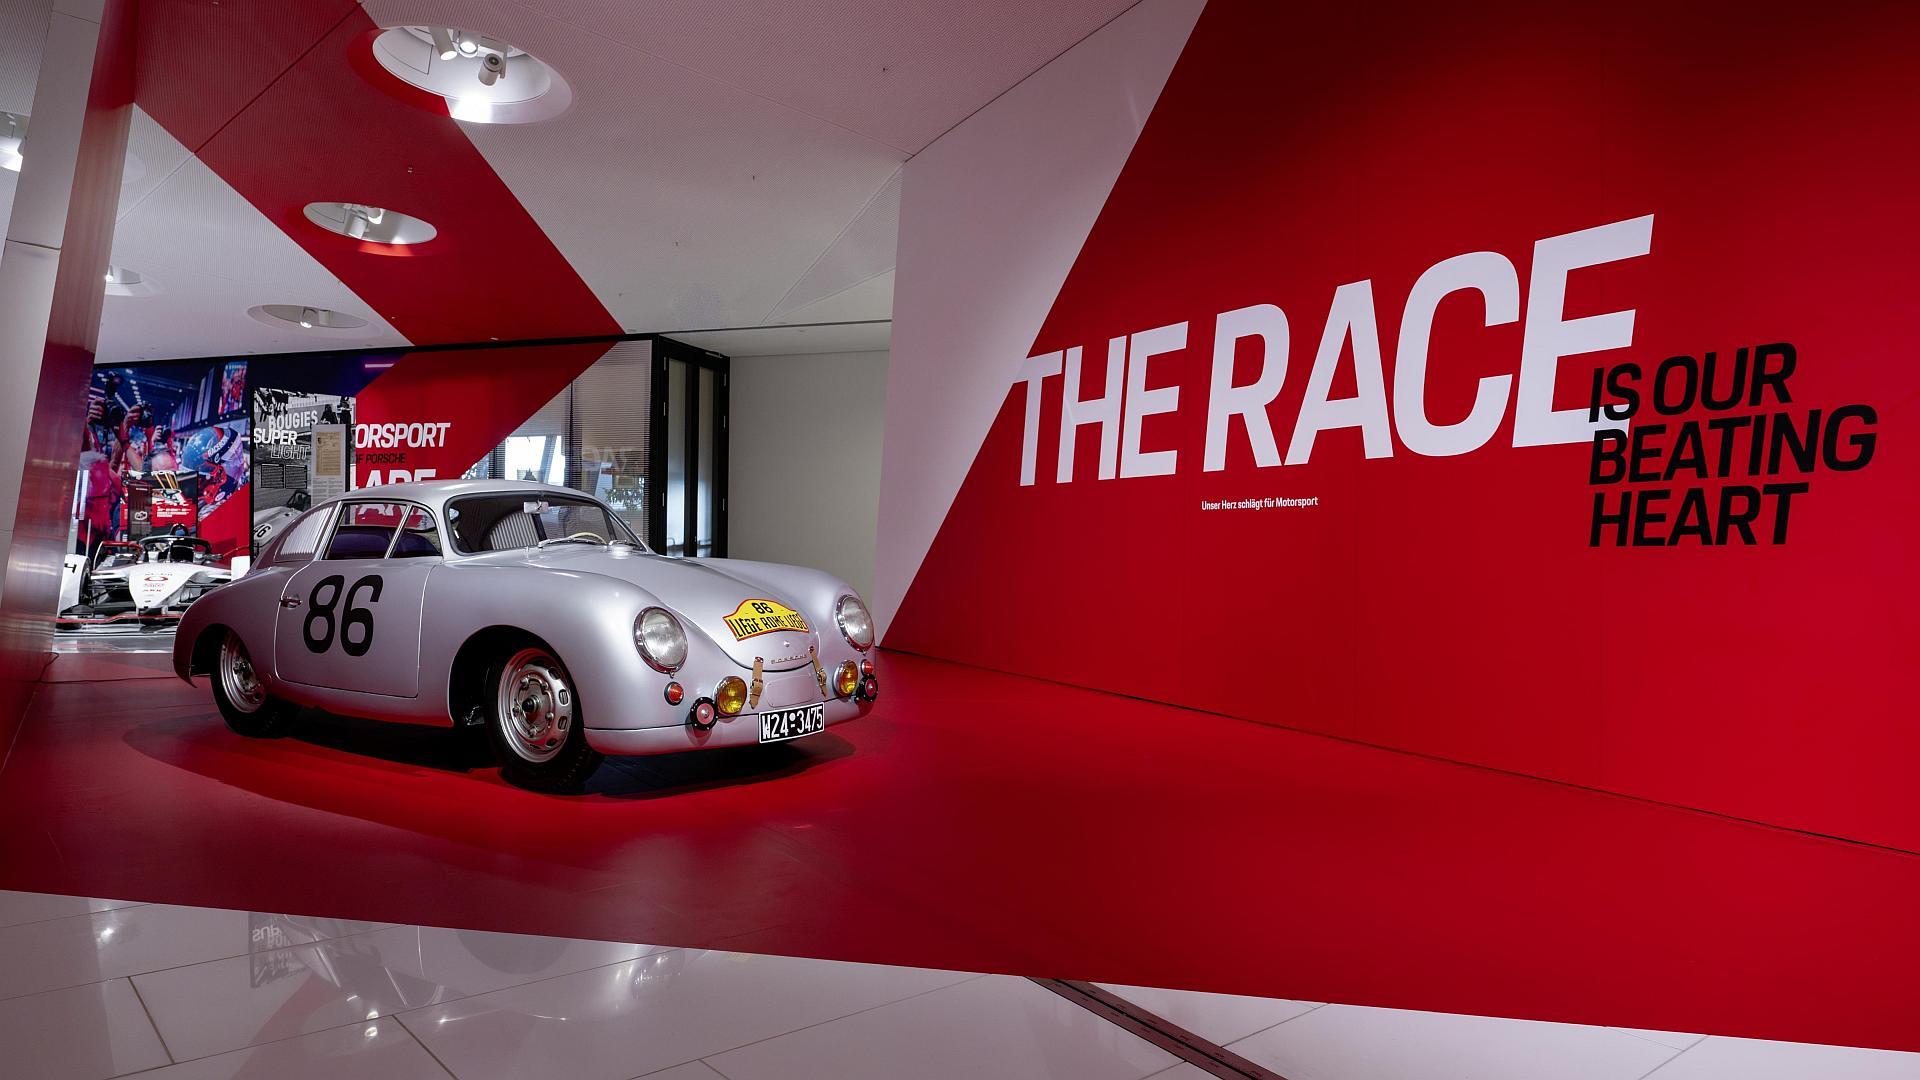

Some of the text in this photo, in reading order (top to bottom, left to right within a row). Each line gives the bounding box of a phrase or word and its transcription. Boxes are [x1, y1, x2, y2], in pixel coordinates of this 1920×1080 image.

[1012, 214, 1654, 486] THE RACE
[1589, 343, 1797, 423] IS OUR
[269, 410, 318, 432] BOUGIES
[254, 428, 298, 445] SUPER
[1589, 405, 1878, 485] BEATING
[271, 444, 311, 460] LIGHT
[366, 453, 405, 464] PORSCHE
[1202, 496, 1318, 510] Unser Herz schlägt für Motorsport
[1589, 483, 1809, 547] HEART
[303, 575, 383, 657] 86
[752, 603, 774, 614] 86
[760, 616, 789, 630] ROME
